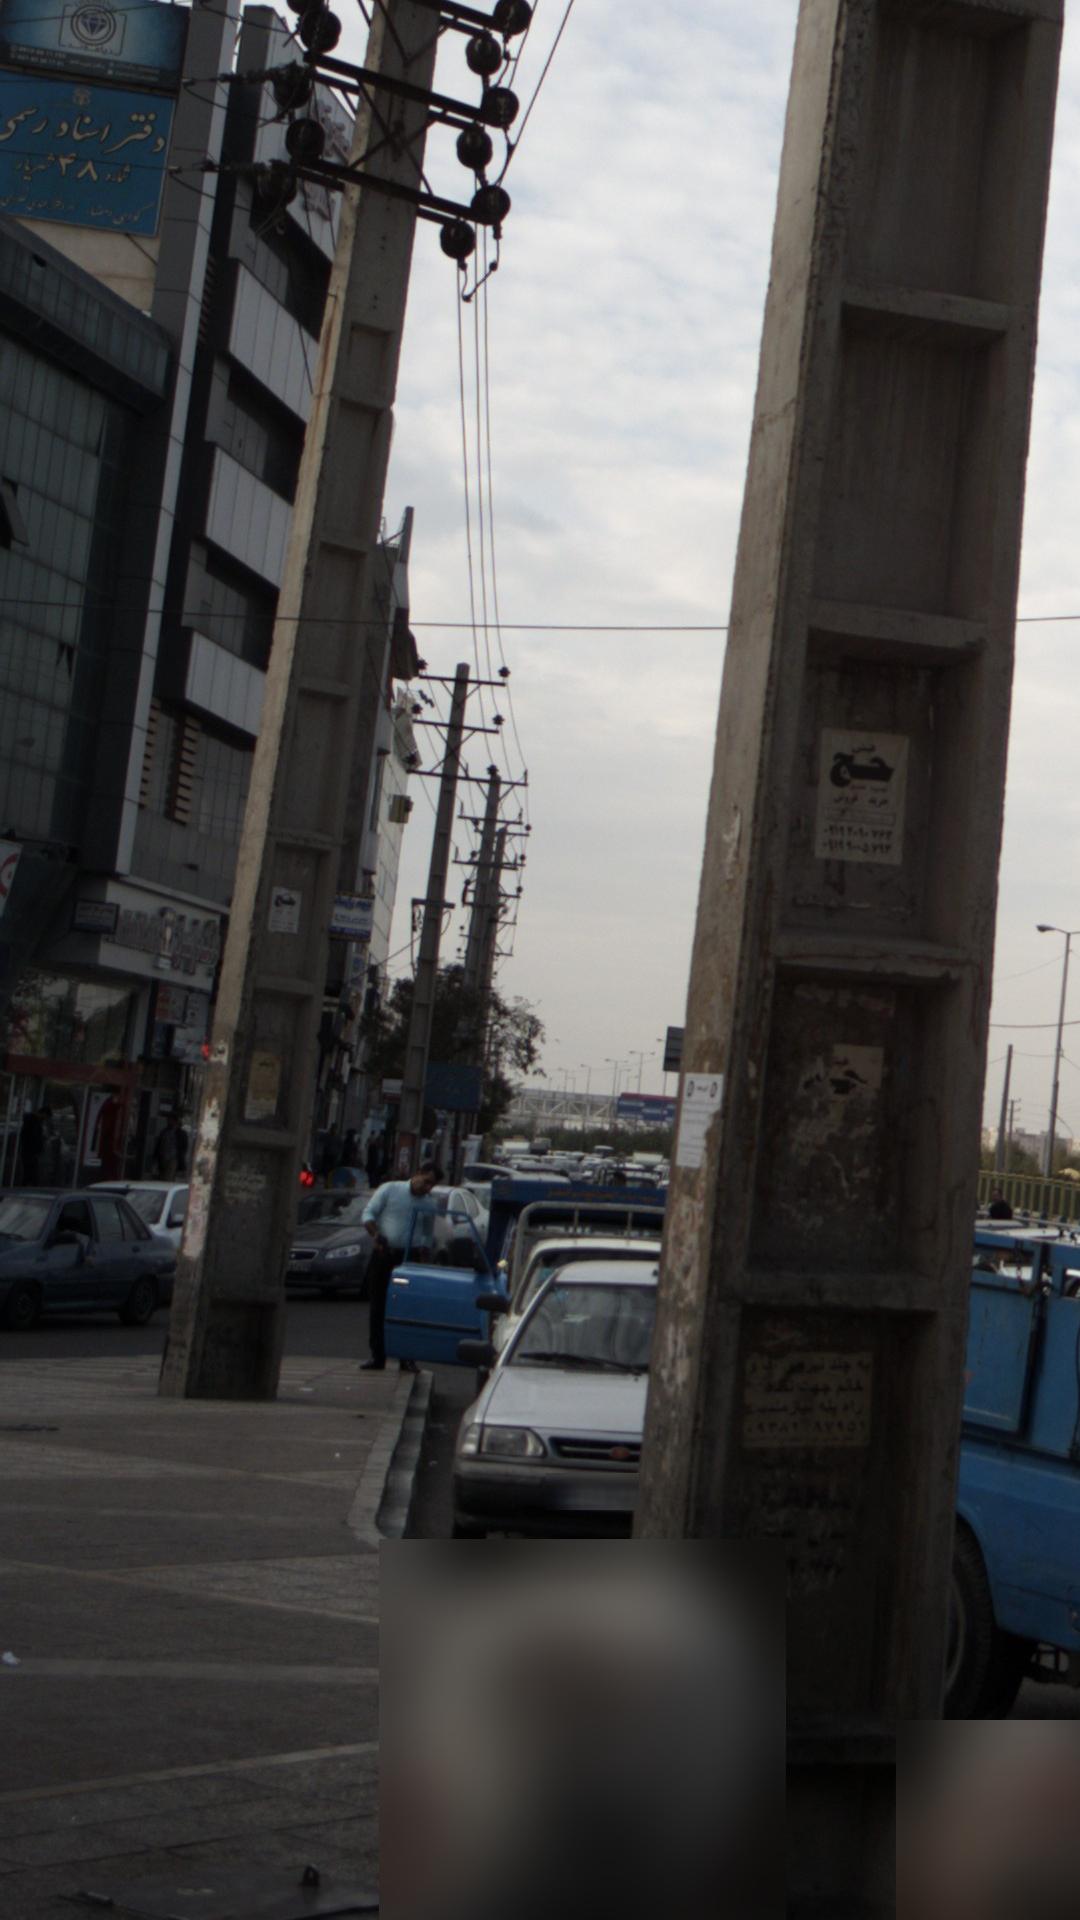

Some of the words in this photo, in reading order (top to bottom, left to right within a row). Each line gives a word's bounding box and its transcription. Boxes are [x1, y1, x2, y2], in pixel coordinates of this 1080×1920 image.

[0, 106, 48, 141] رسمی
[56, 114, 111, 144] اسناد
[103, 112, 167, 153] دفتر
